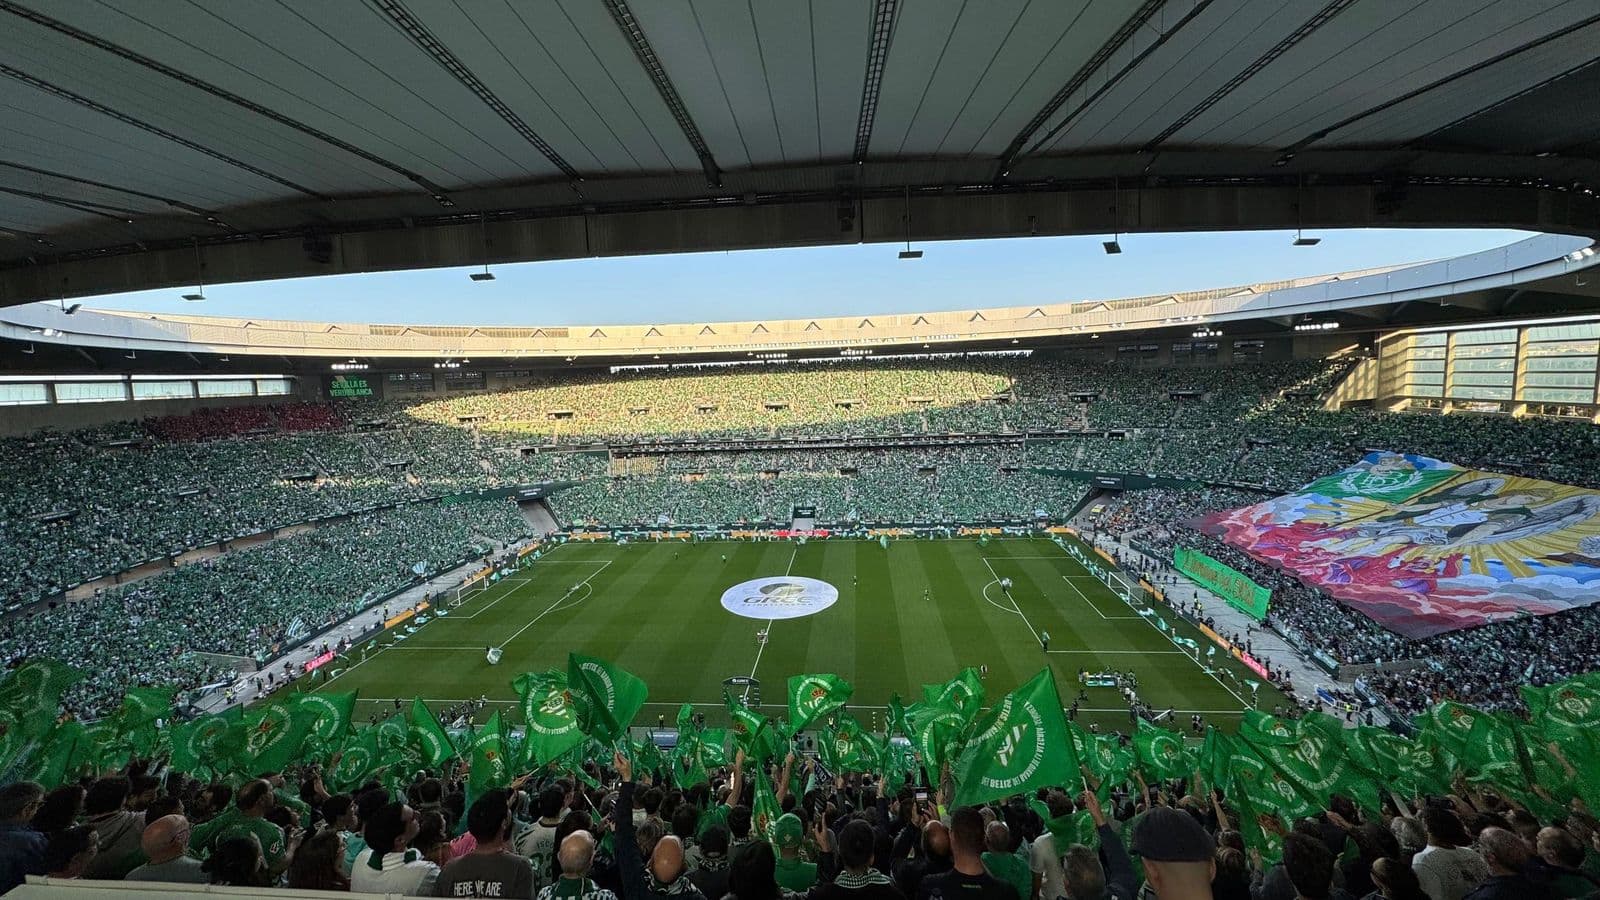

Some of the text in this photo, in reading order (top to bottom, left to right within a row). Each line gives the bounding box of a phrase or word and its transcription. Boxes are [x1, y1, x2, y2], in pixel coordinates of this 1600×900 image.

[331, 380, 358, 388] SEVILLA
[453, 879, 502, 896] HERE WE ARE
